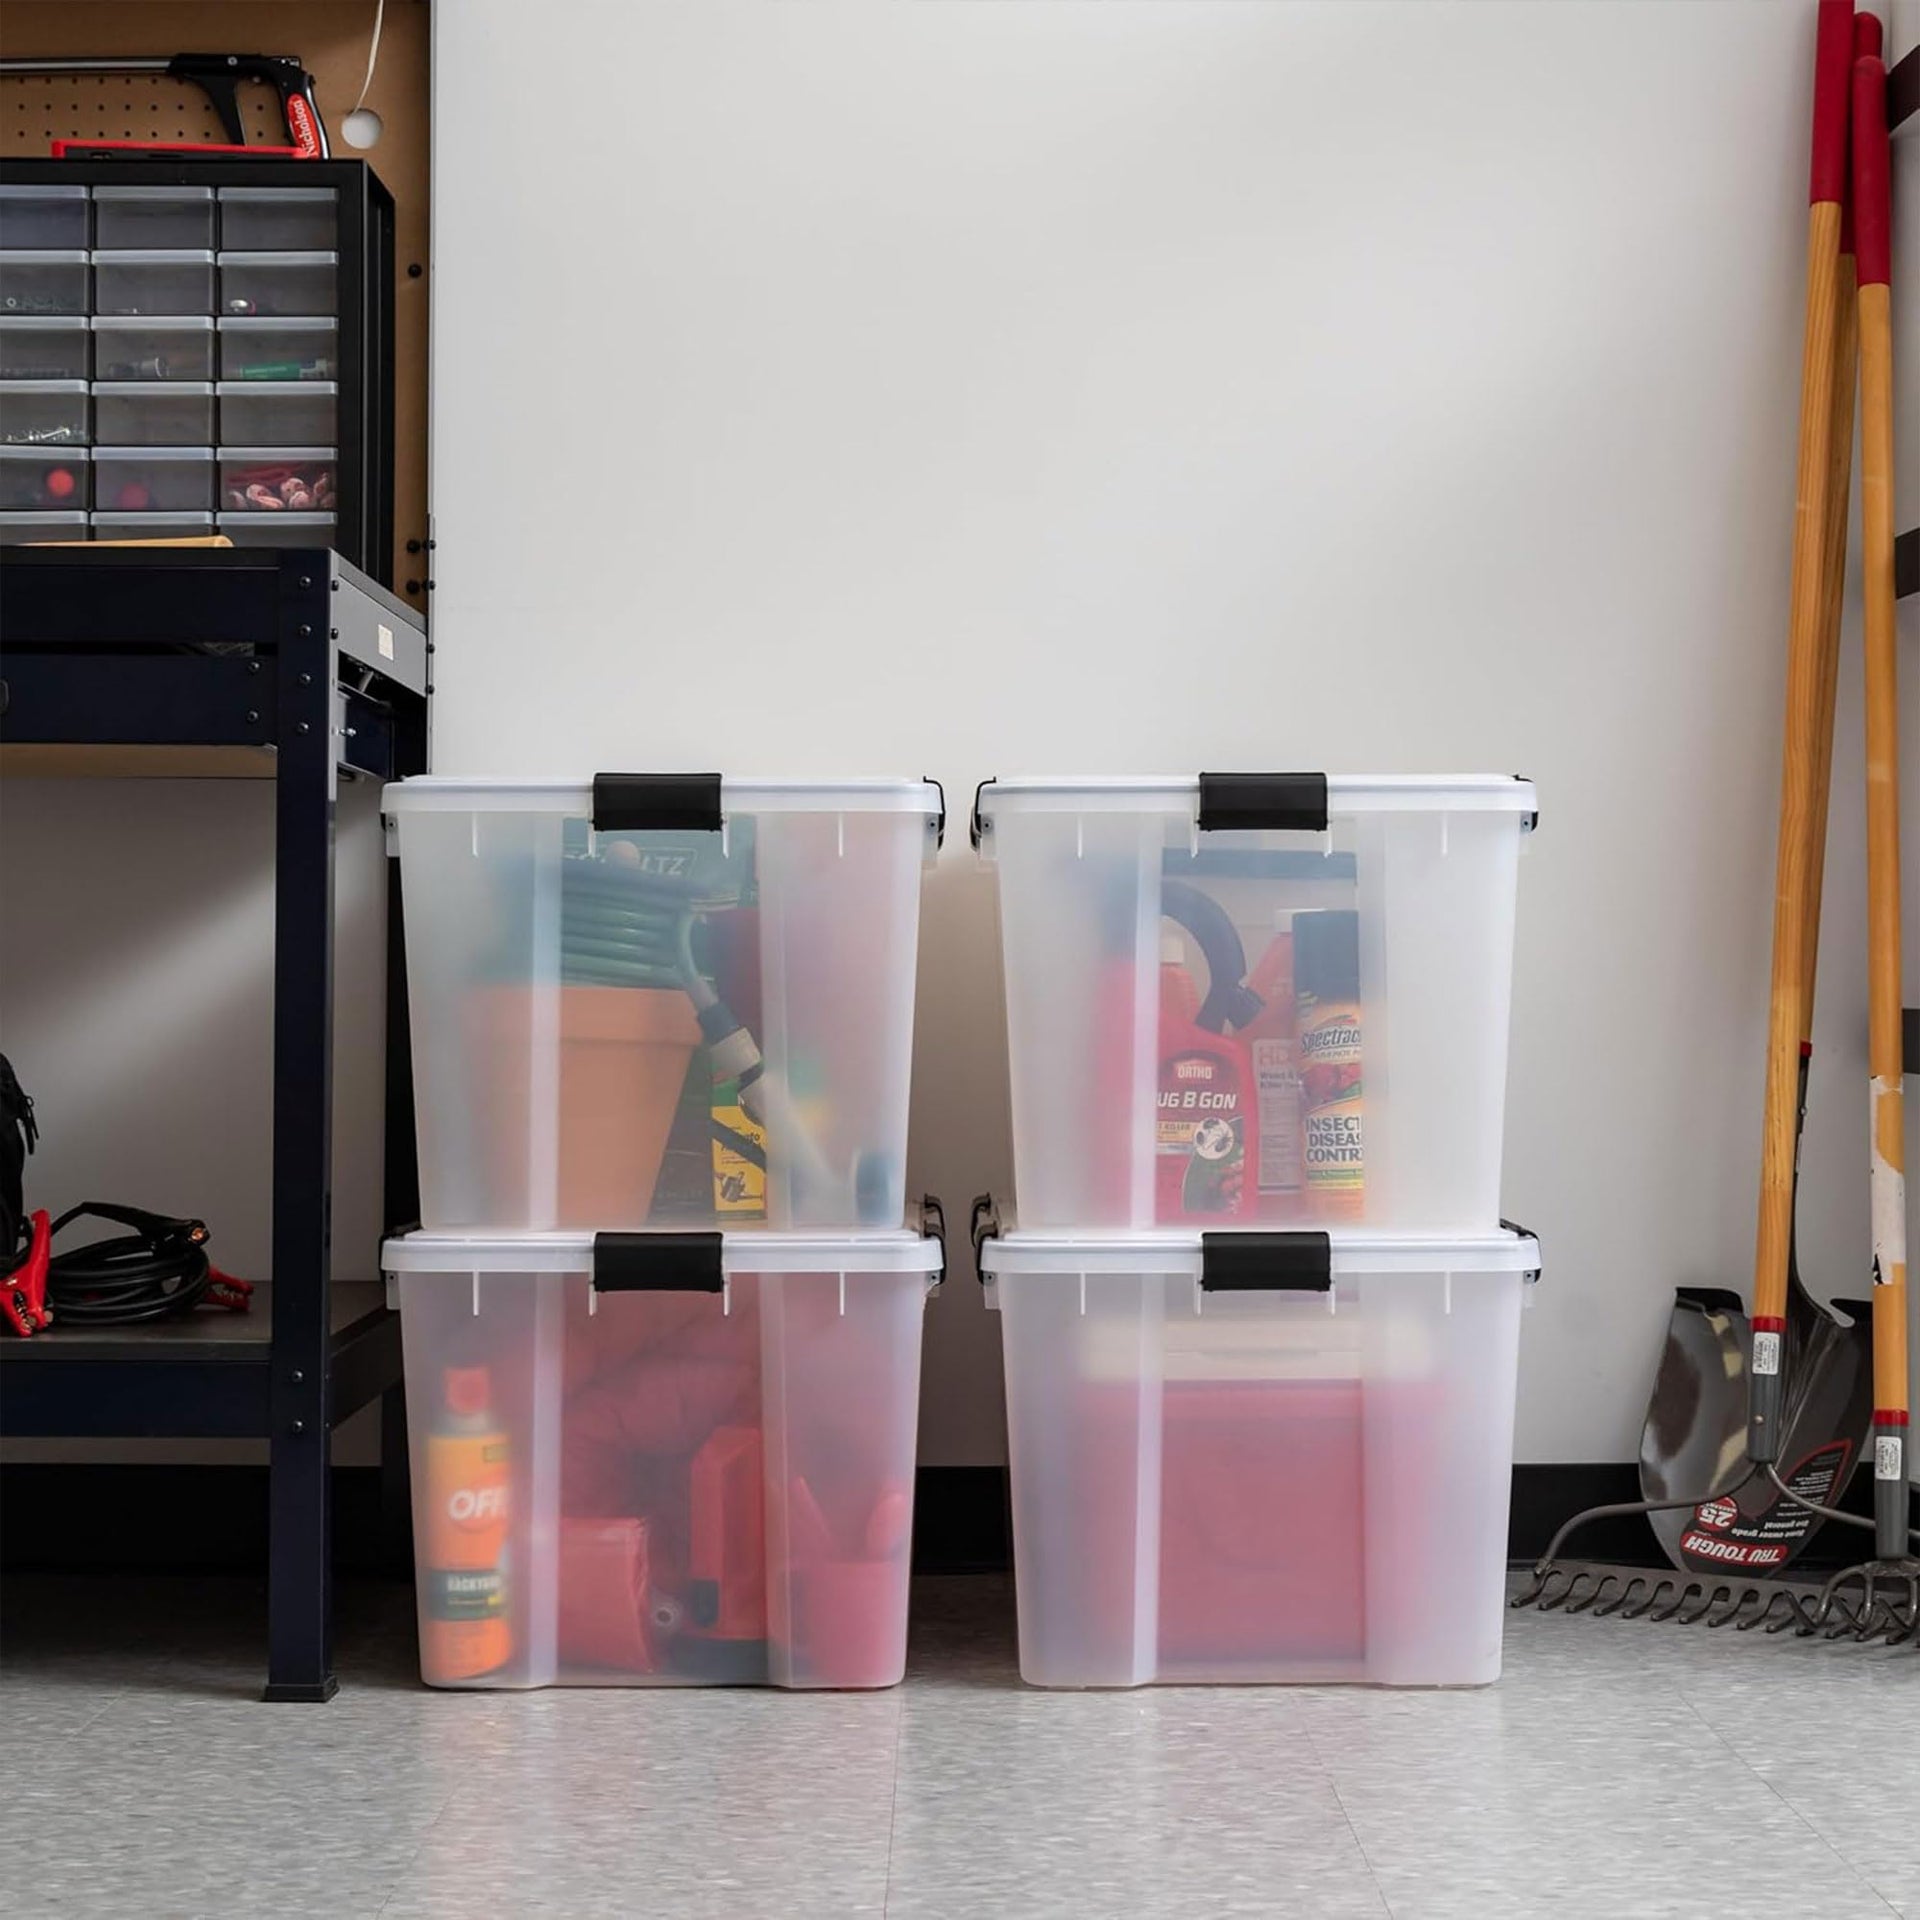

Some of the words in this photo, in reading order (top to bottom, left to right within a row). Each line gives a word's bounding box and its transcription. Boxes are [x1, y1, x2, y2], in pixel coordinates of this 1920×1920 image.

[294, 100, 319, 157] Nicholson
[1302, 1028, 1361, 1053] Spectrac
[1177, 1065, 1213, 1079] ORTHO
[1157, 1092, 1180, 1108] UG
[1182, 1091, 1198, 1108] B
[1199, 1092, 1236, 1109] GON
[1306, 1148, 1362, 1163] CONTR
[1699, 1506, 1734, 1527] 25
[1684, 1535, 1747, 1562] TOUGH
[1747, 1548, 1780, 1563] TRU
